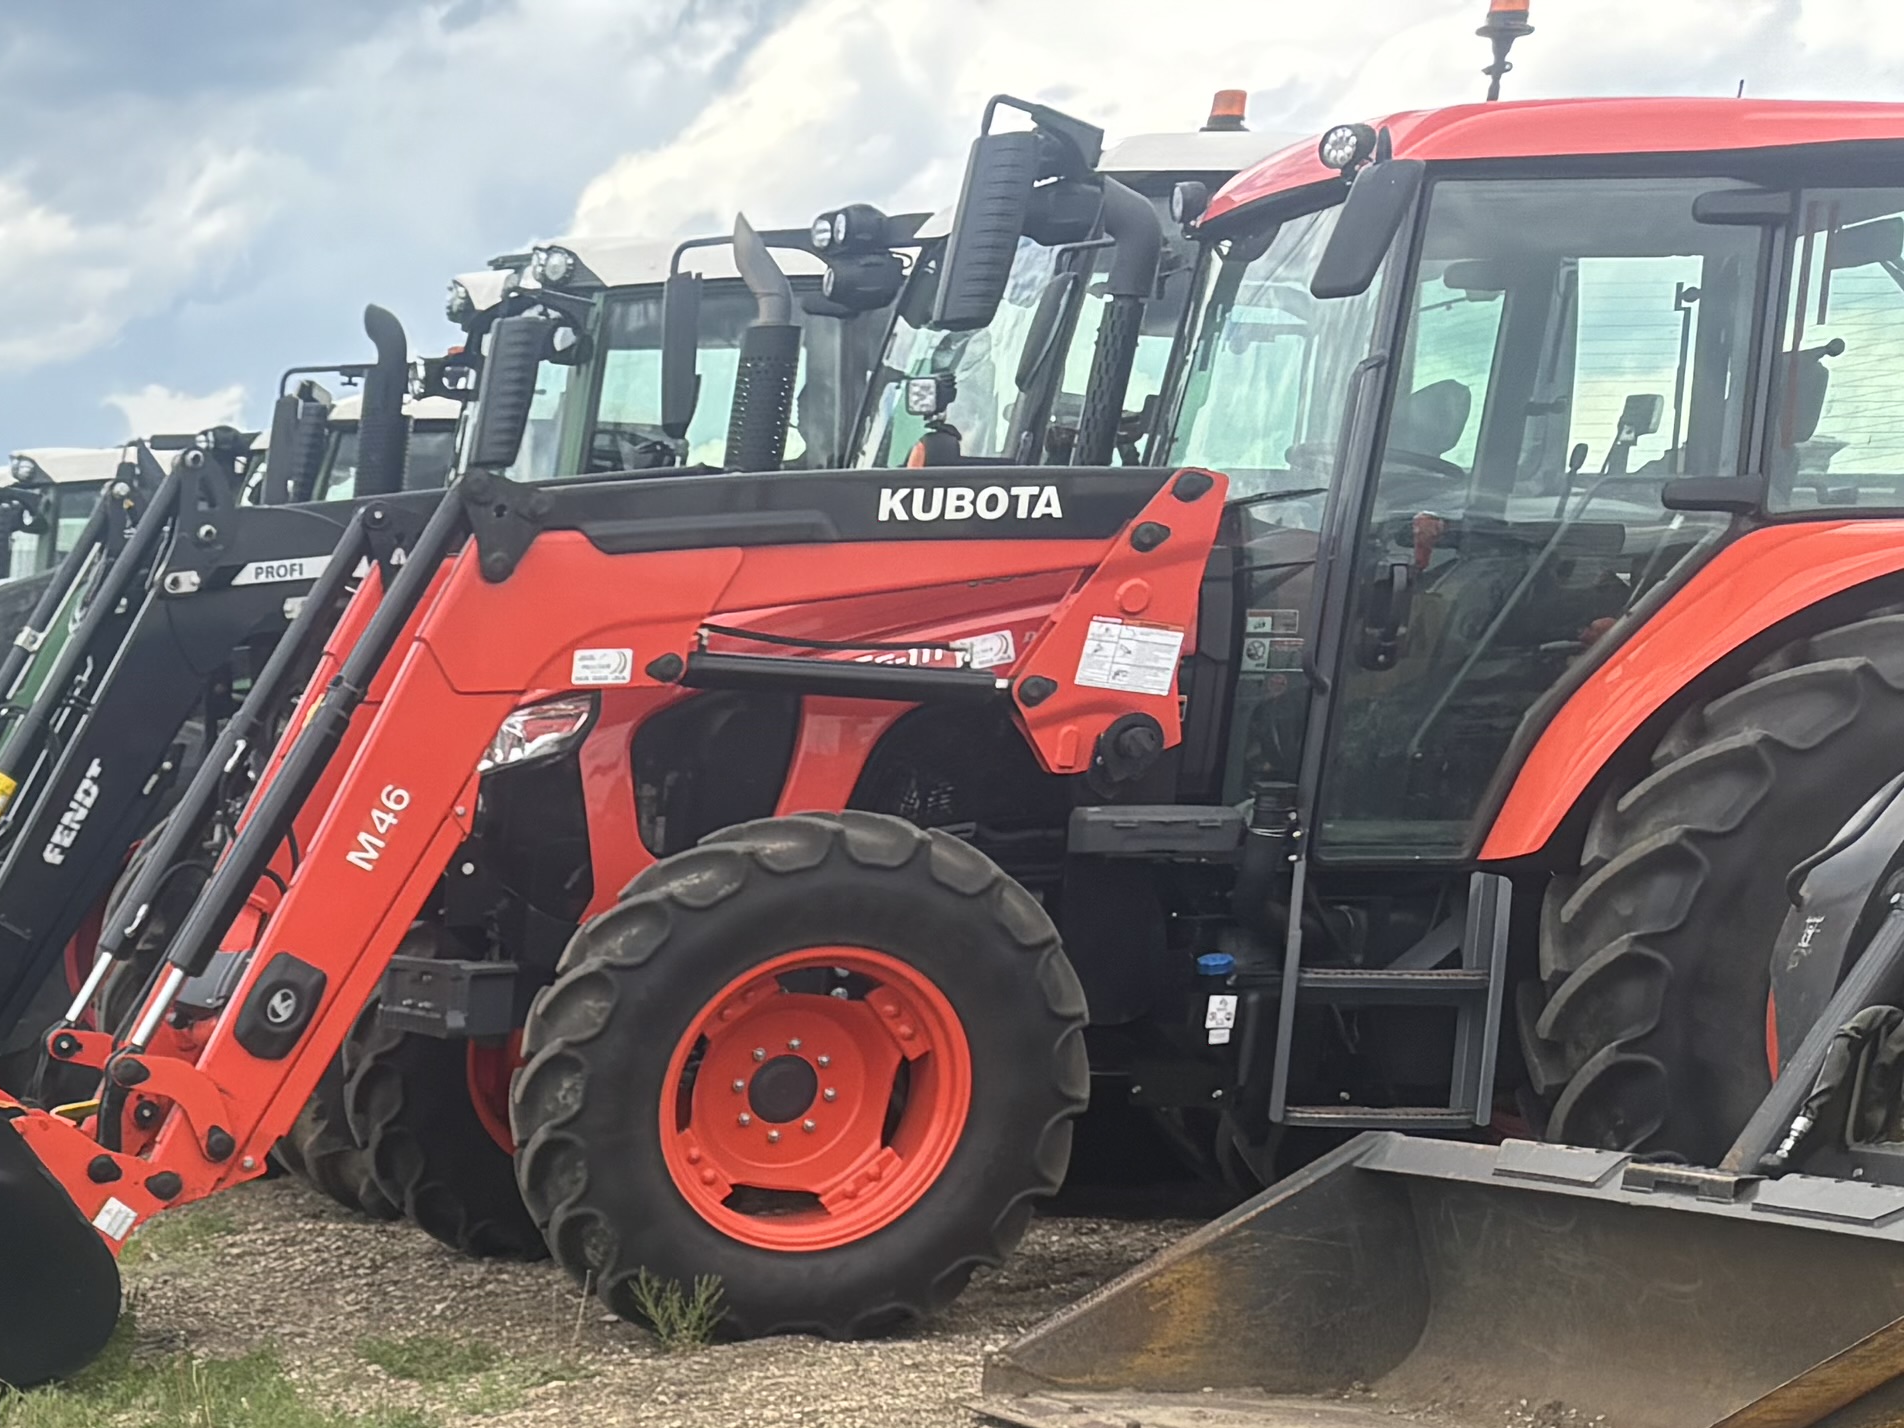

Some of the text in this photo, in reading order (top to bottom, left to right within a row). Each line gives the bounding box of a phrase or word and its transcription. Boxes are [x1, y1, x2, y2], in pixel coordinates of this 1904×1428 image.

[877, 485, 1063, 521] KUBOTA
[254, 563, 303, 580] PROFI
[42, 757, 102, 865] FENDT
[345, 784, 411, 871] M46
